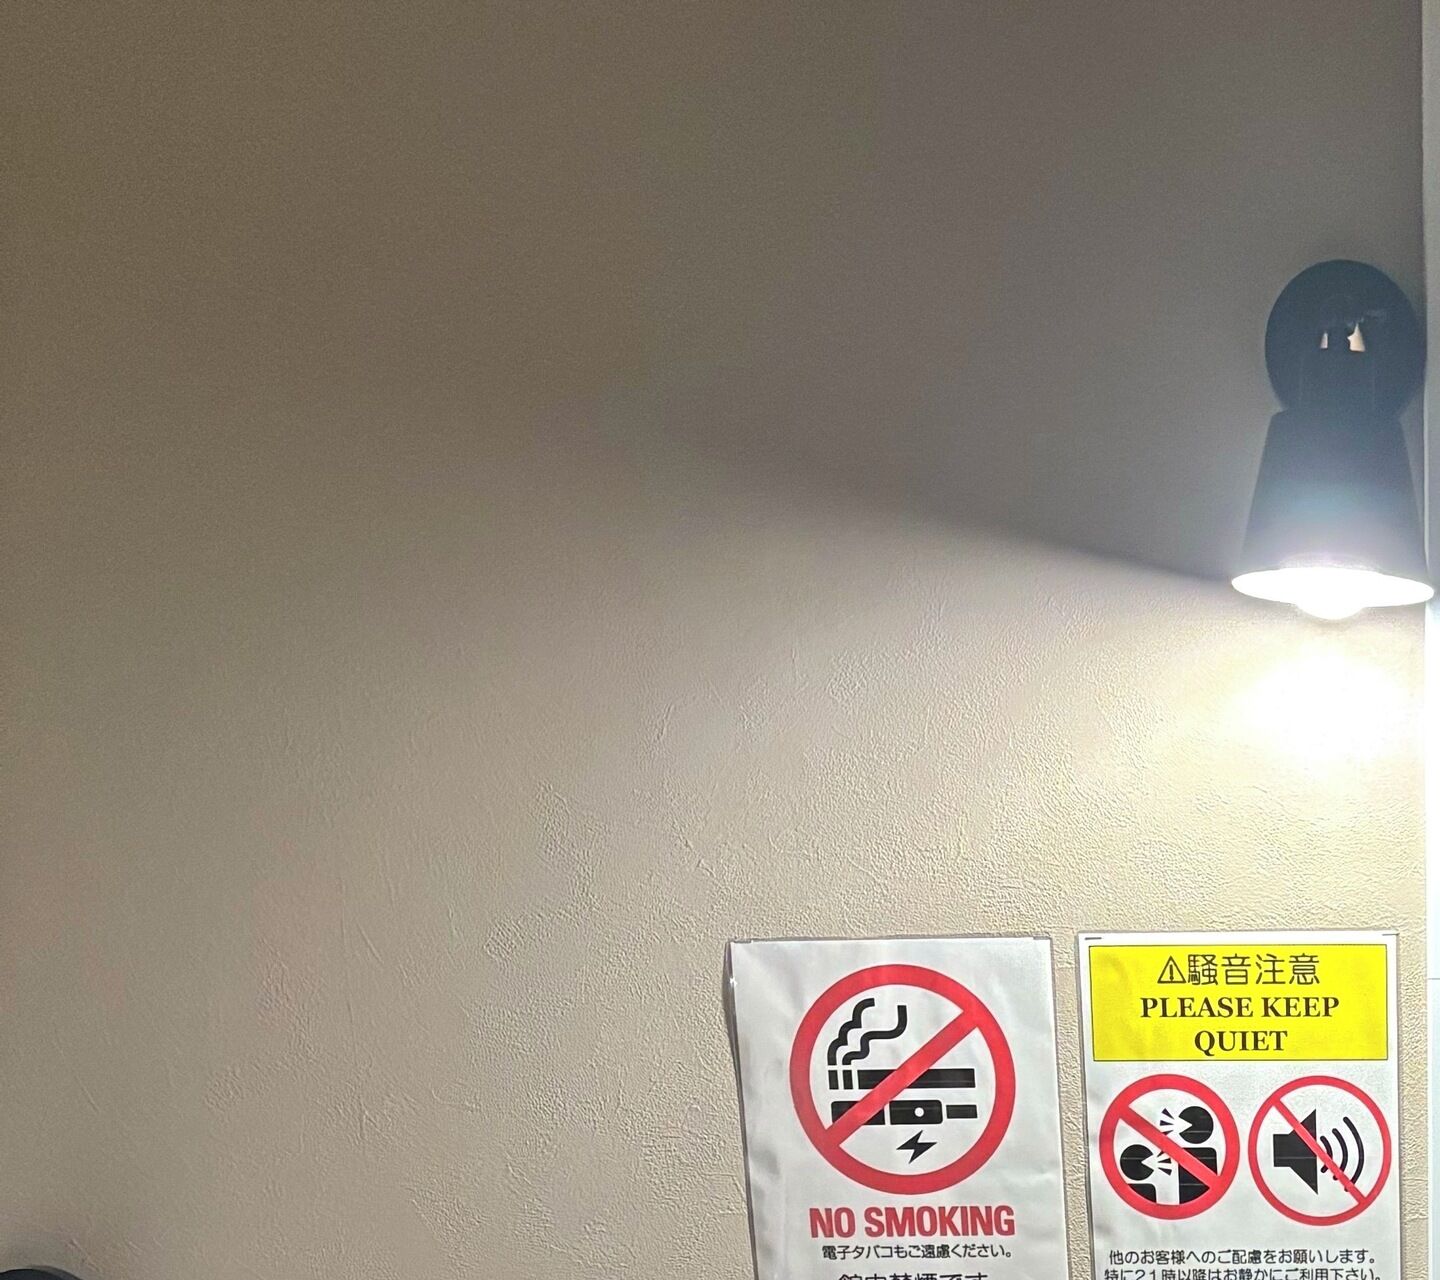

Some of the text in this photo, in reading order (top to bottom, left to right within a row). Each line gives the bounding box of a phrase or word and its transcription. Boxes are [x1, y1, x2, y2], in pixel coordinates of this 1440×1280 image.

[1187, 953, 1320, 986] 騒音注意
[1140, 996, 1340, 1018] PLEASE KEEP
[1194, 1030, 1288, 1057] QUIET
[809, 1205, 1016, 1238] NO SMOKING
[821, 1244, 1012, 1261] 電子タバコもご遠慮ください。
[1109, 1249, 1376, 1266] 他のお客様へのご配慮をお願いします。
